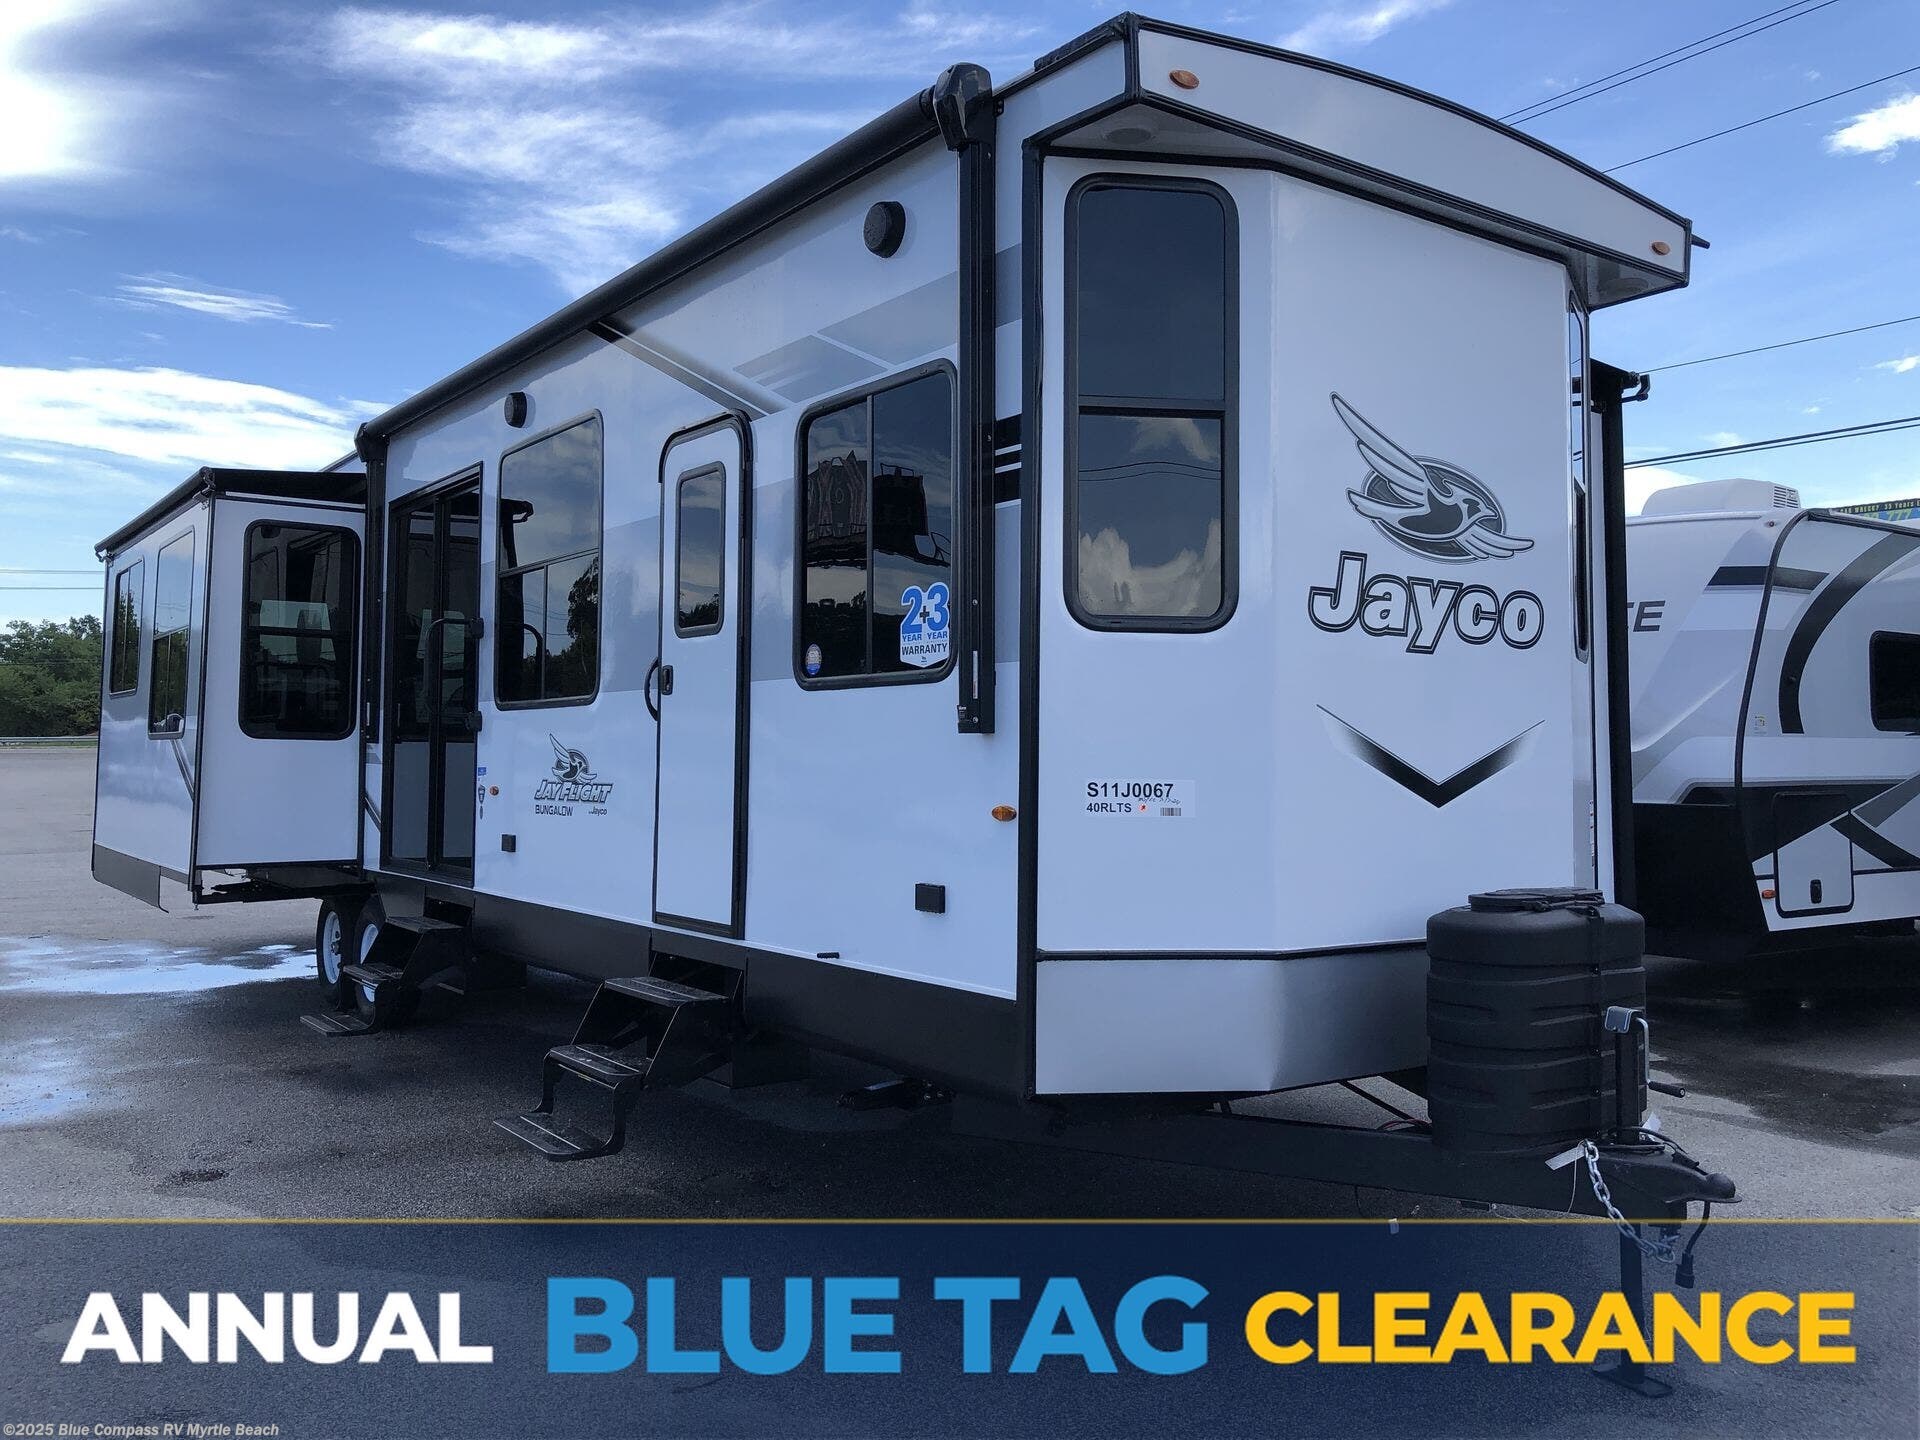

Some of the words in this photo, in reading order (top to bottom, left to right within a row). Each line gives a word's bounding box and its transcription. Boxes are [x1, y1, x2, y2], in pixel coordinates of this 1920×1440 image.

[1308, 550, 1544, 655] Jayco
[902, 633, 922, 642] YEAR
[927, 631, 948, 640] YEAR
[902, 643, 948, 655] WARRANTY
[1087, 782, 1174, 798] S11J0067
[535, 805, 573, 816] BUNGALOW
[1086, 802, 1132, 813] 40RLTS
